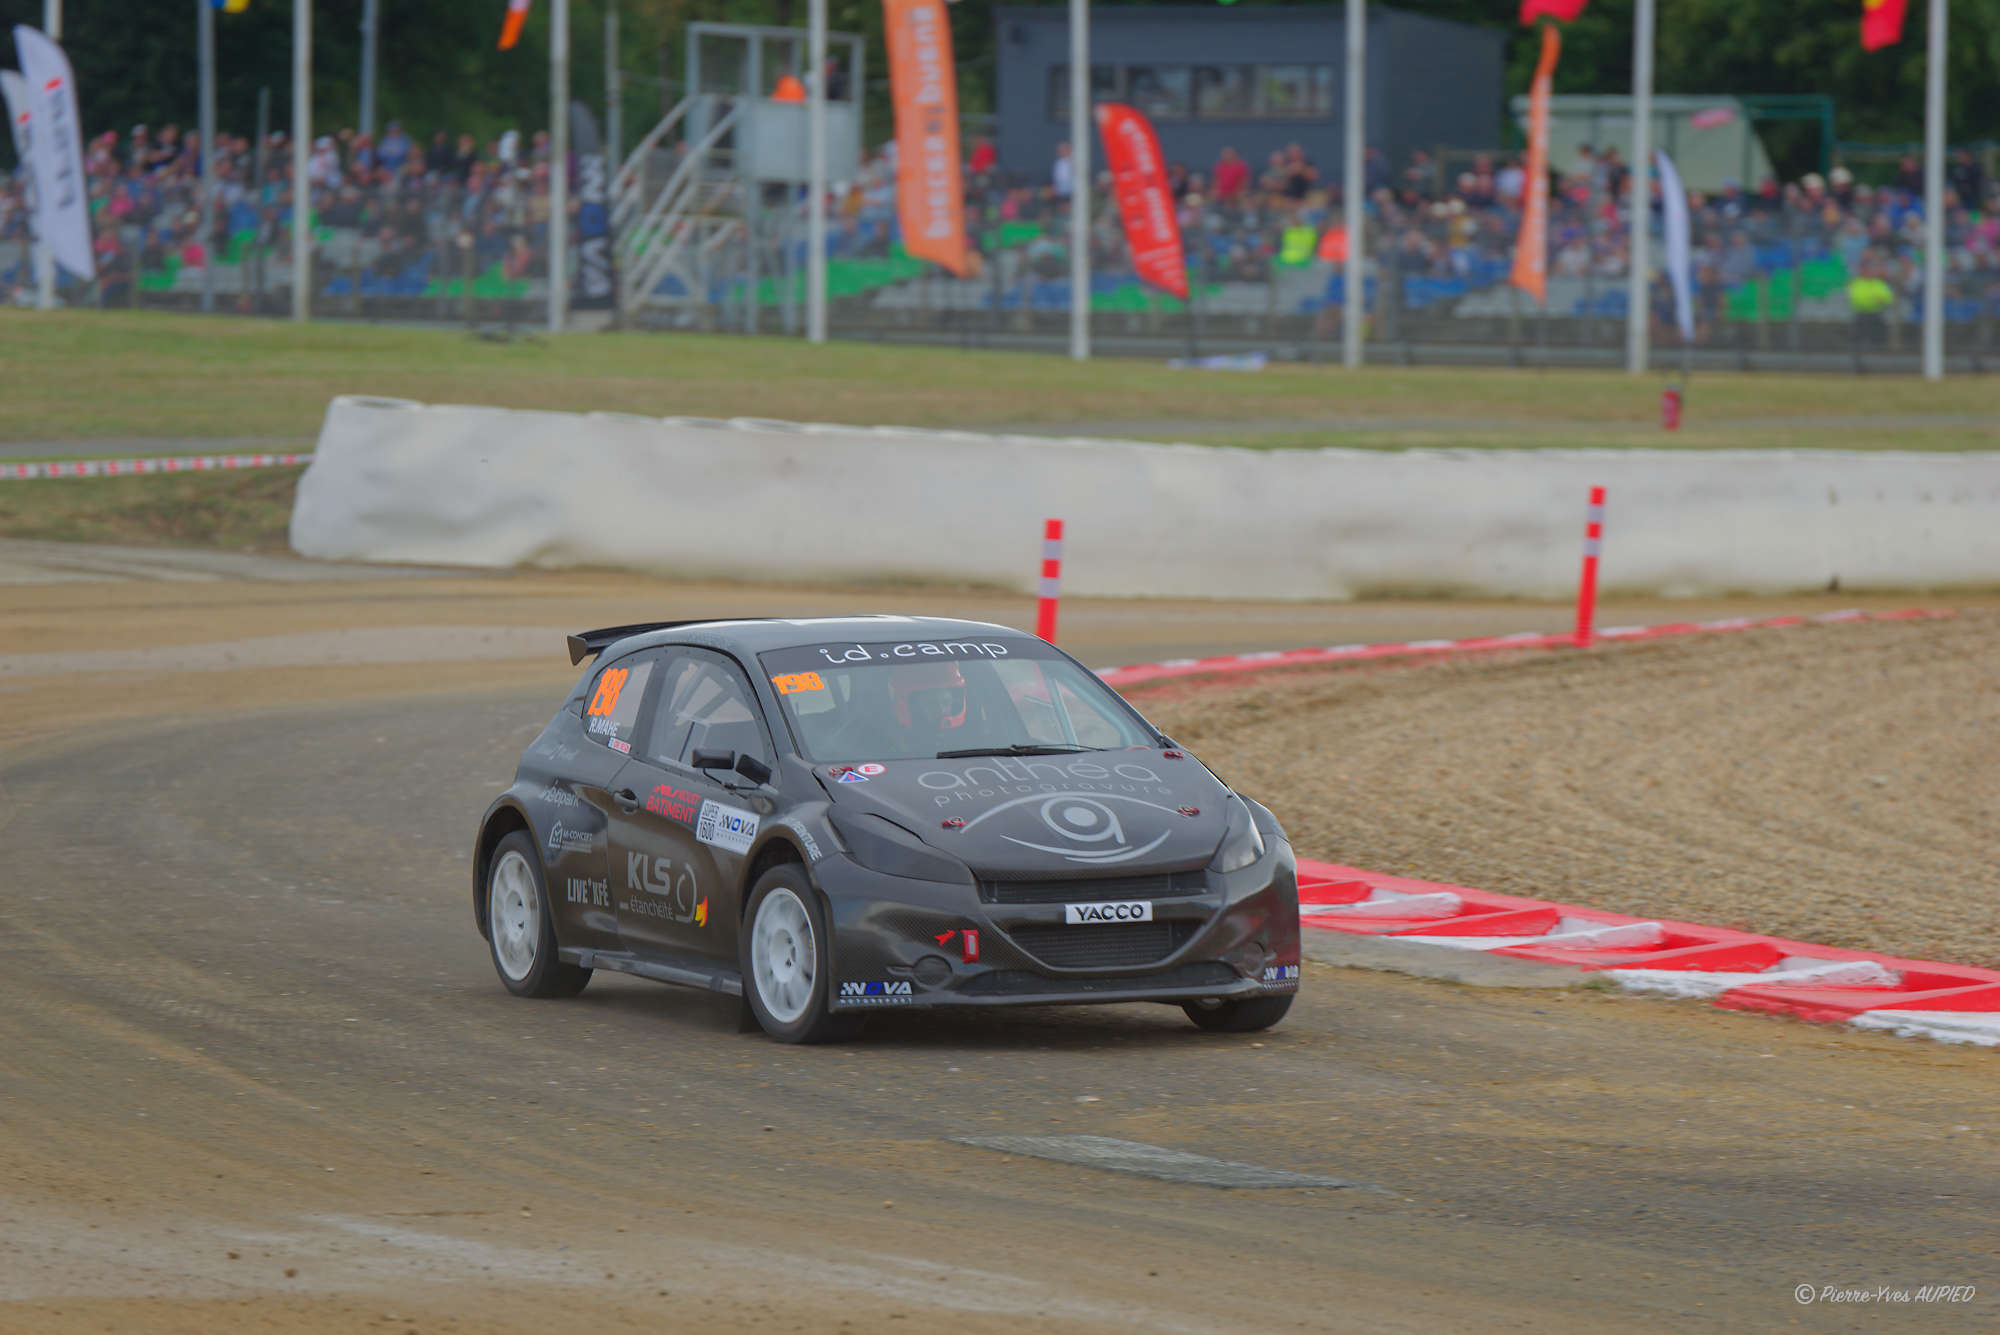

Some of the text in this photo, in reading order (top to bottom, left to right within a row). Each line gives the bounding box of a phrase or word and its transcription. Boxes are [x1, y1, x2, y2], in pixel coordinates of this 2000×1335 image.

[819, 643, 1008, 664] id.camp
[587, 668, 628, 716] 198
[772, 671, 825, 695] 198
[917, 756, 1162, 790] anthéa
[720, 814, 756, 838] NOVA
[627, 851, 671, 895] KLS
[567, 877, 588, 904] LIVE
[1075, 904, 1144, 921] YACCO
[840, 981, 912, 996] NOVA
